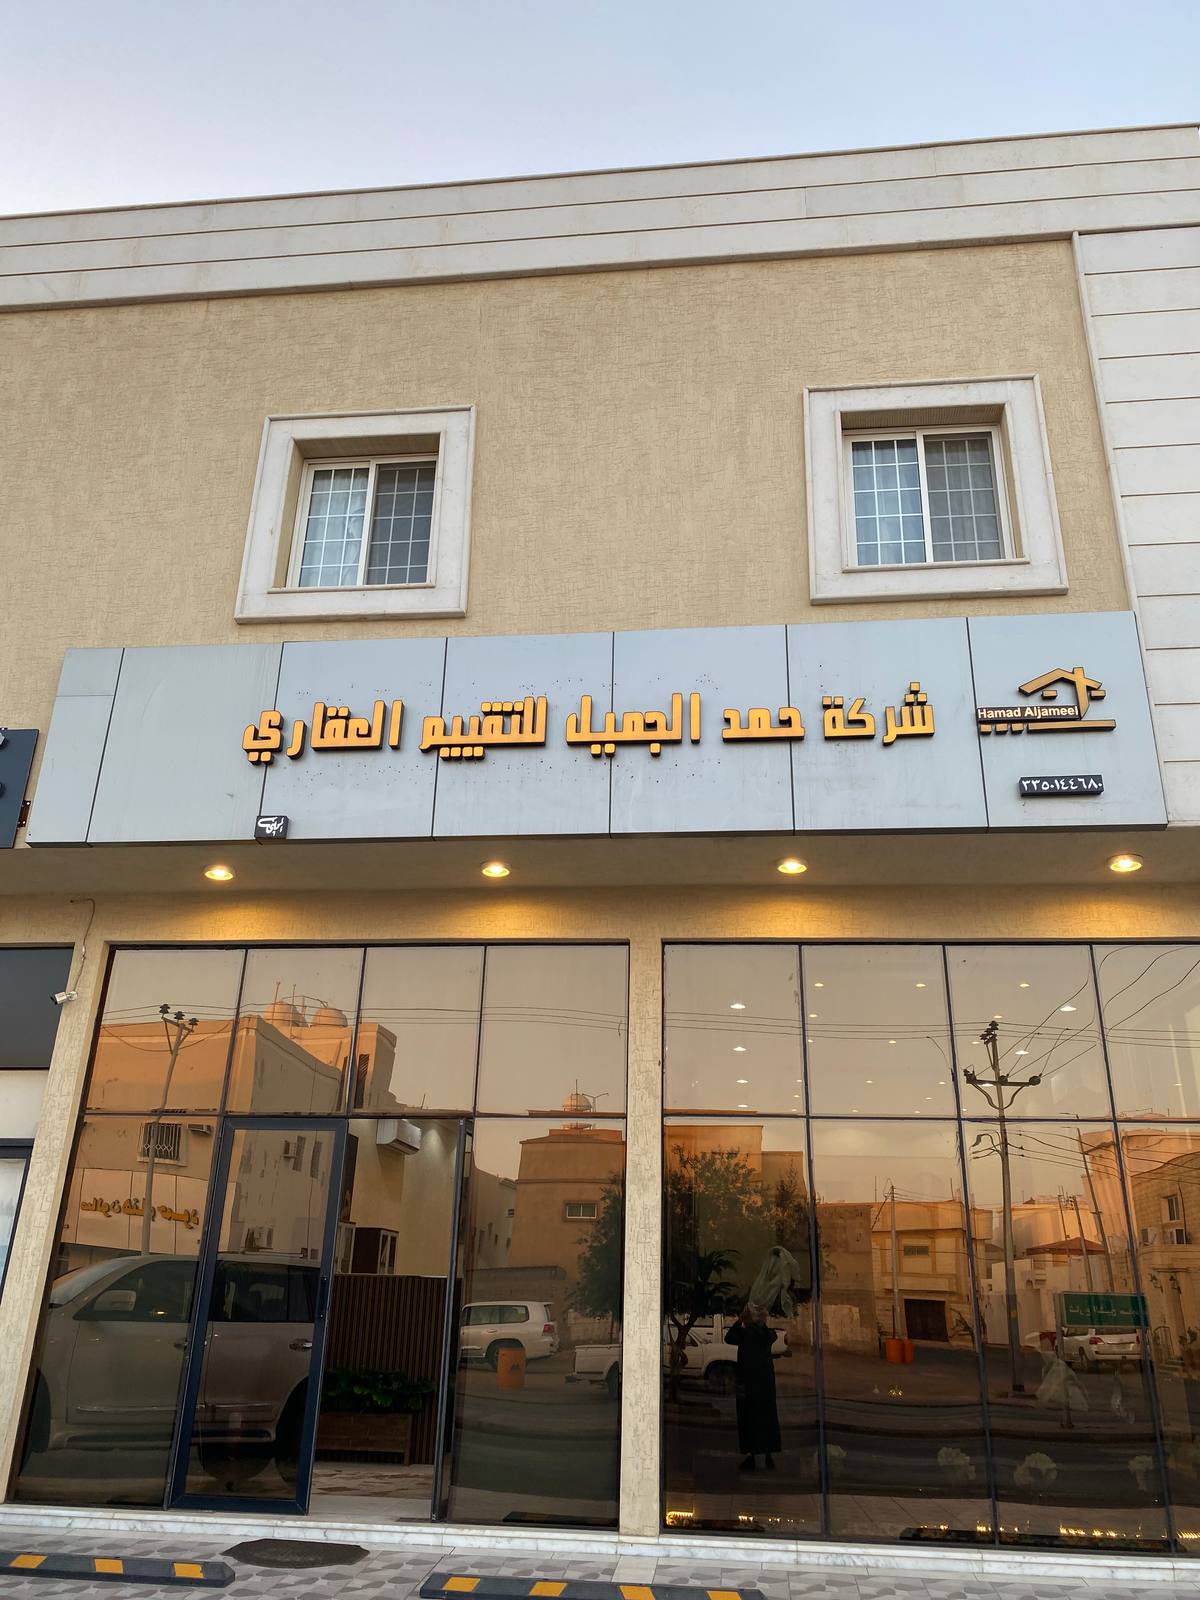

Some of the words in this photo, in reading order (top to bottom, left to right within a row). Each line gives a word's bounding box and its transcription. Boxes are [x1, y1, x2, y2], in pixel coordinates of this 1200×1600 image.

[242, 699, 404, 765] العقاري
[418, 696, 549, 761] للتقييم
[565, 692, 702, 758] الجميل
[721, 706, 806, 743] حمد
[821, 681, 936, 746] شركة
[977, 708, 1021, 720] Hamad
[1023, 705, 1080, 720] Aljameel
